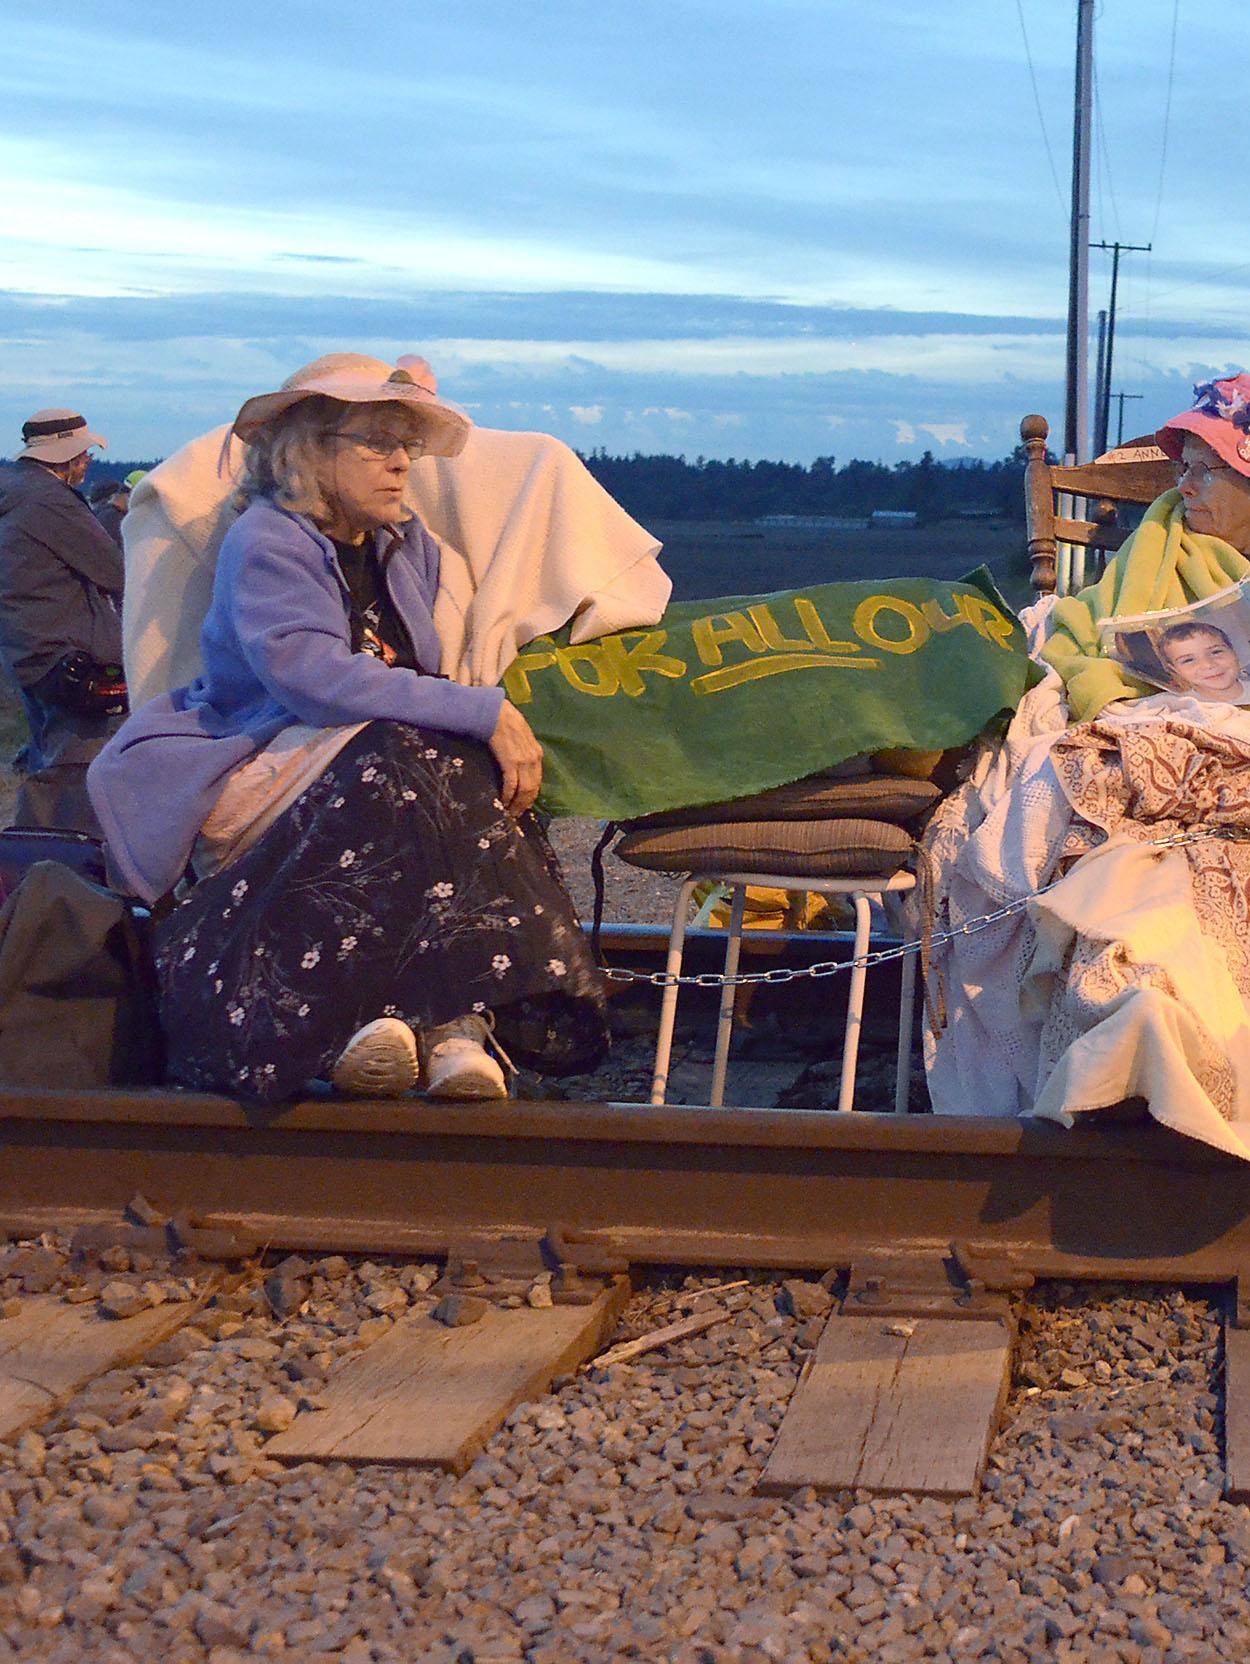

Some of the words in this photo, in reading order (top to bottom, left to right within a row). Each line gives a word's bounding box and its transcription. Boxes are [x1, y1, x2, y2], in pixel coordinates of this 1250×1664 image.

[502, 629, 687, 703] FOR
[692, 598, 861, 665] ALL
[853, 593, 1014, 654] OUR
